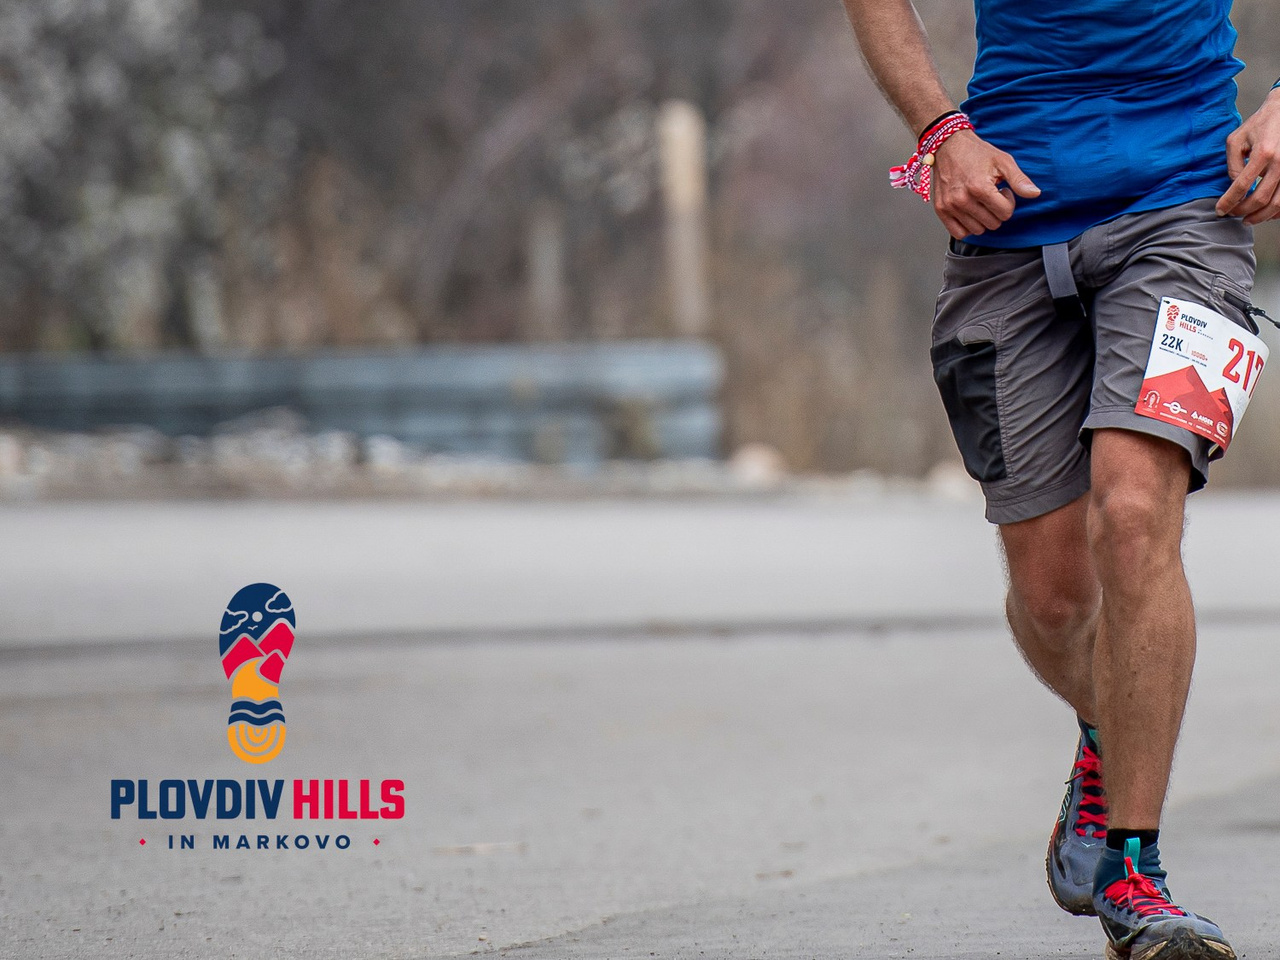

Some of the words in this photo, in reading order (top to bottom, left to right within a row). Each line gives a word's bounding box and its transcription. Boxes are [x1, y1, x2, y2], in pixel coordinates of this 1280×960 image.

[1179, 321, 1197, 333] HILLS
[1180, 313, 1208, 329] PLOVDIV
[1160, 333, 1184, 352] 22K
